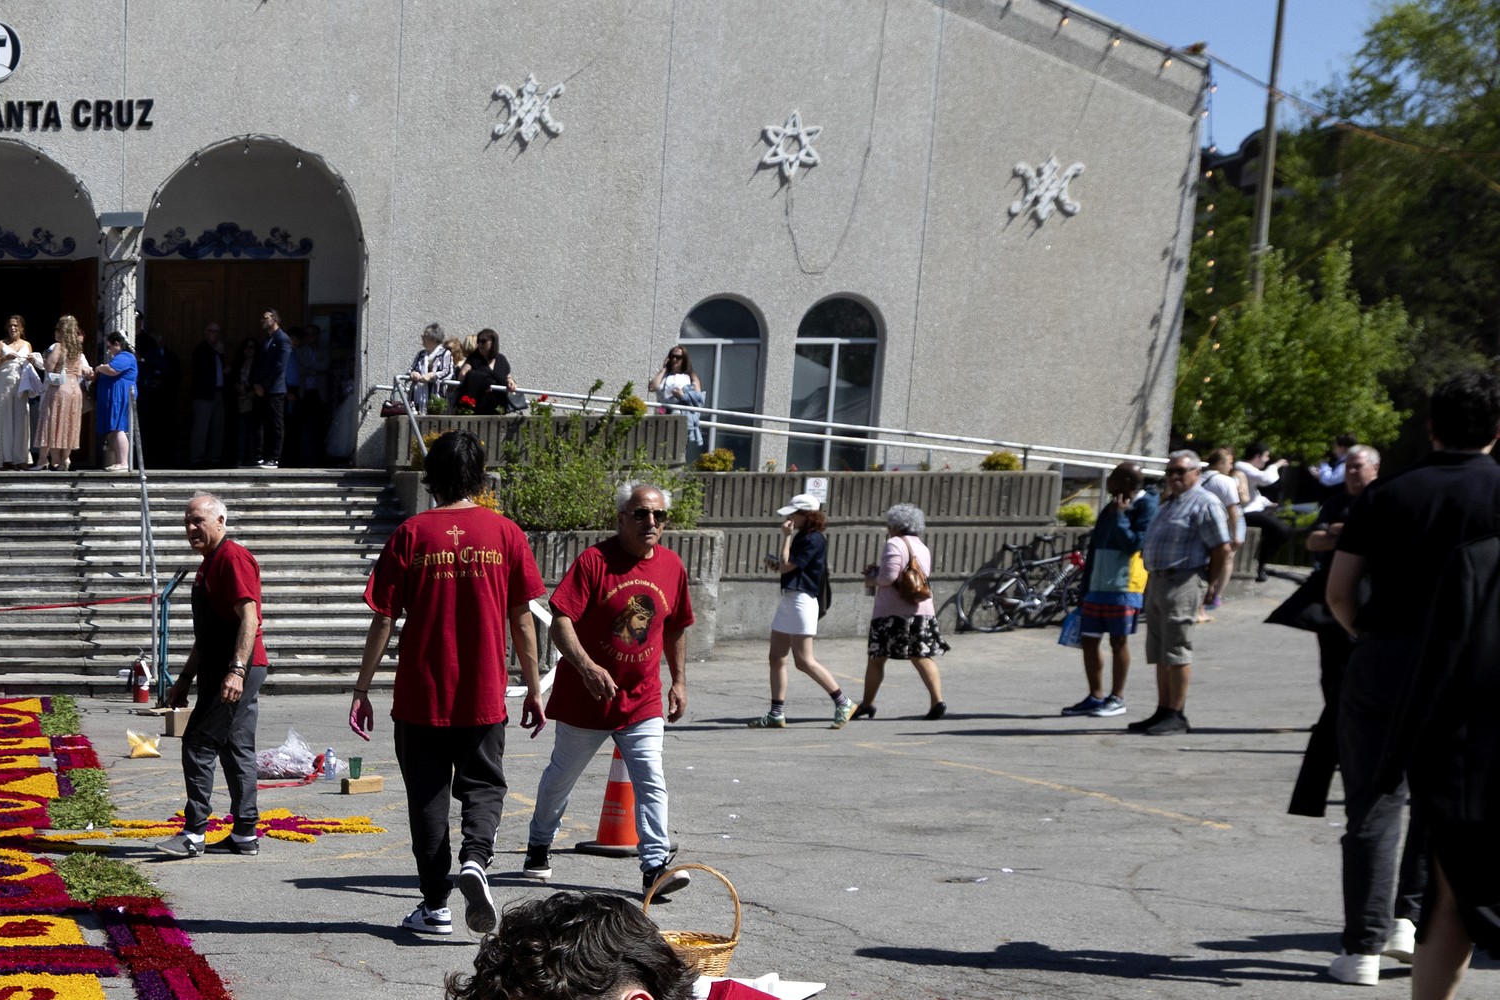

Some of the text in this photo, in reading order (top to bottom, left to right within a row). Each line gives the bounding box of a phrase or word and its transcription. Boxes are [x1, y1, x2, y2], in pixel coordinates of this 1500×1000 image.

[72, 99, 154, 130] CRUZ
[412, 546, 503, 571] Santo Cristo
